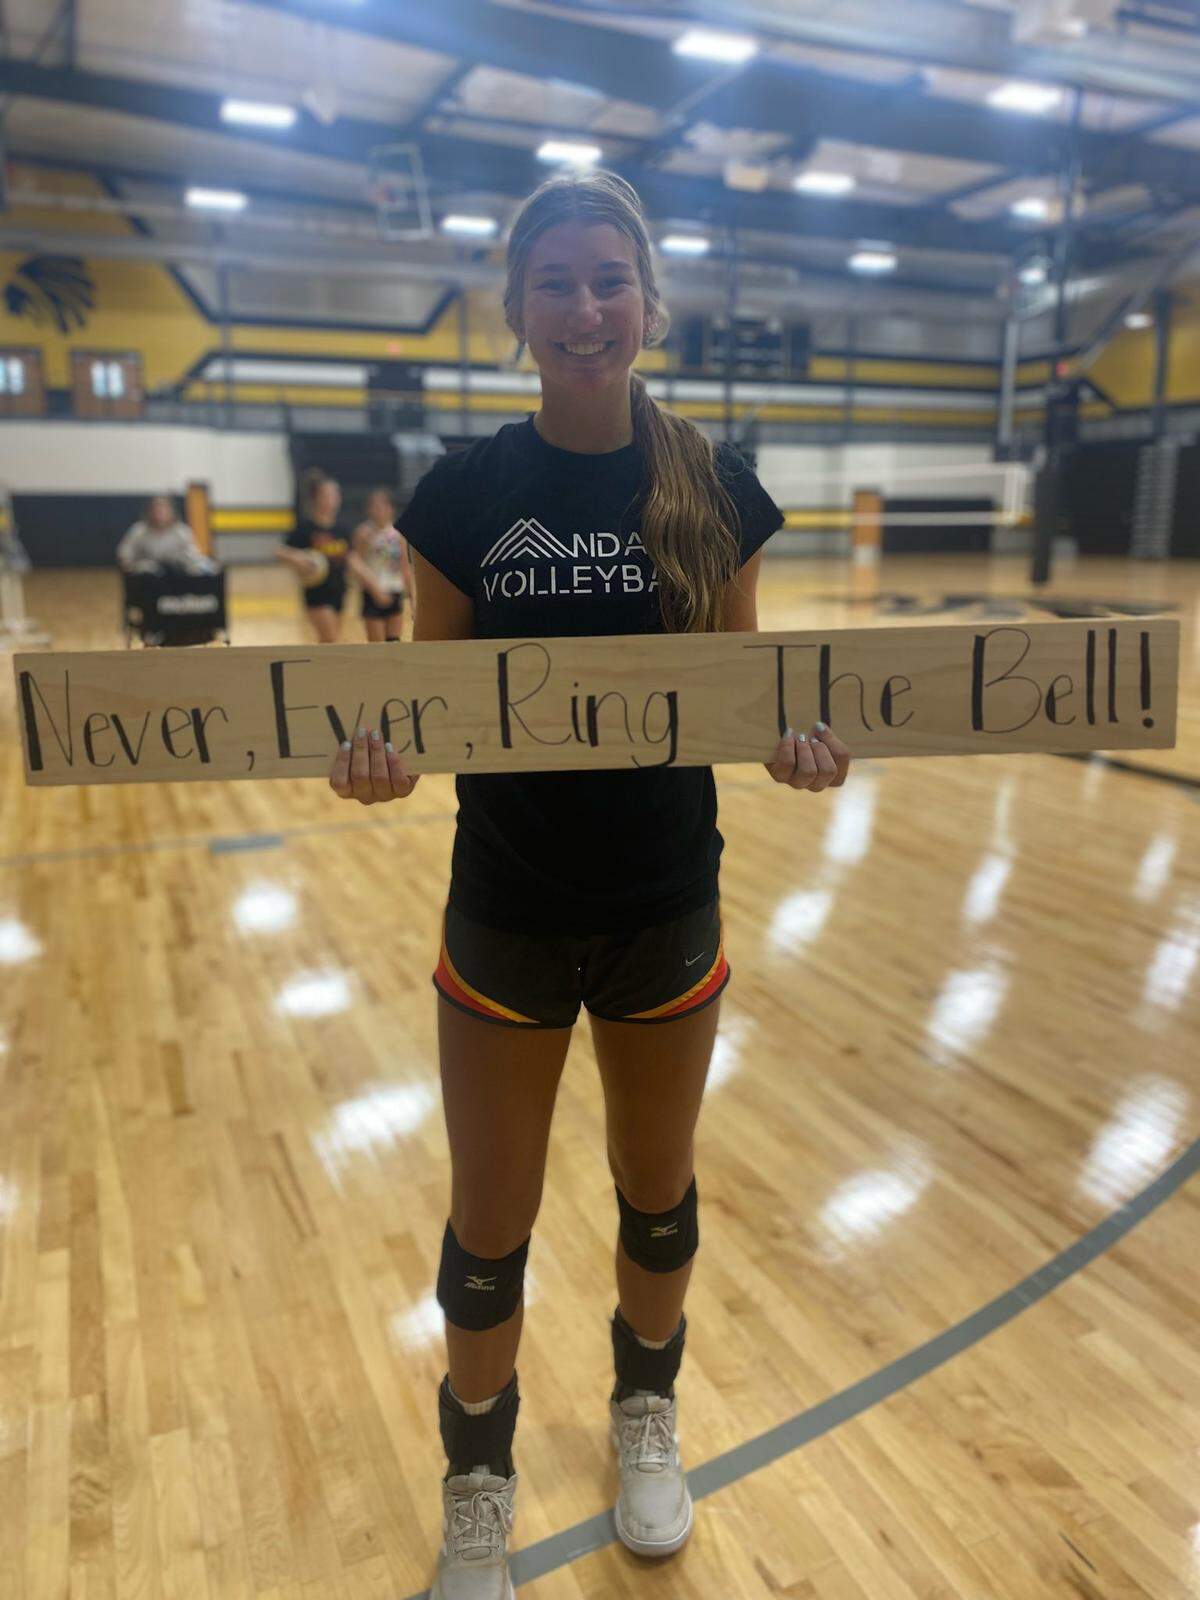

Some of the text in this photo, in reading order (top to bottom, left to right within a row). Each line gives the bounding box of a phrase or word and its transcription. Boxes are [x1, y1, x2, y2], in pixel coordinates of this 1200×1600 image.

[19, 627, 1156, 772] Never, Ever, Ring The Bell!
